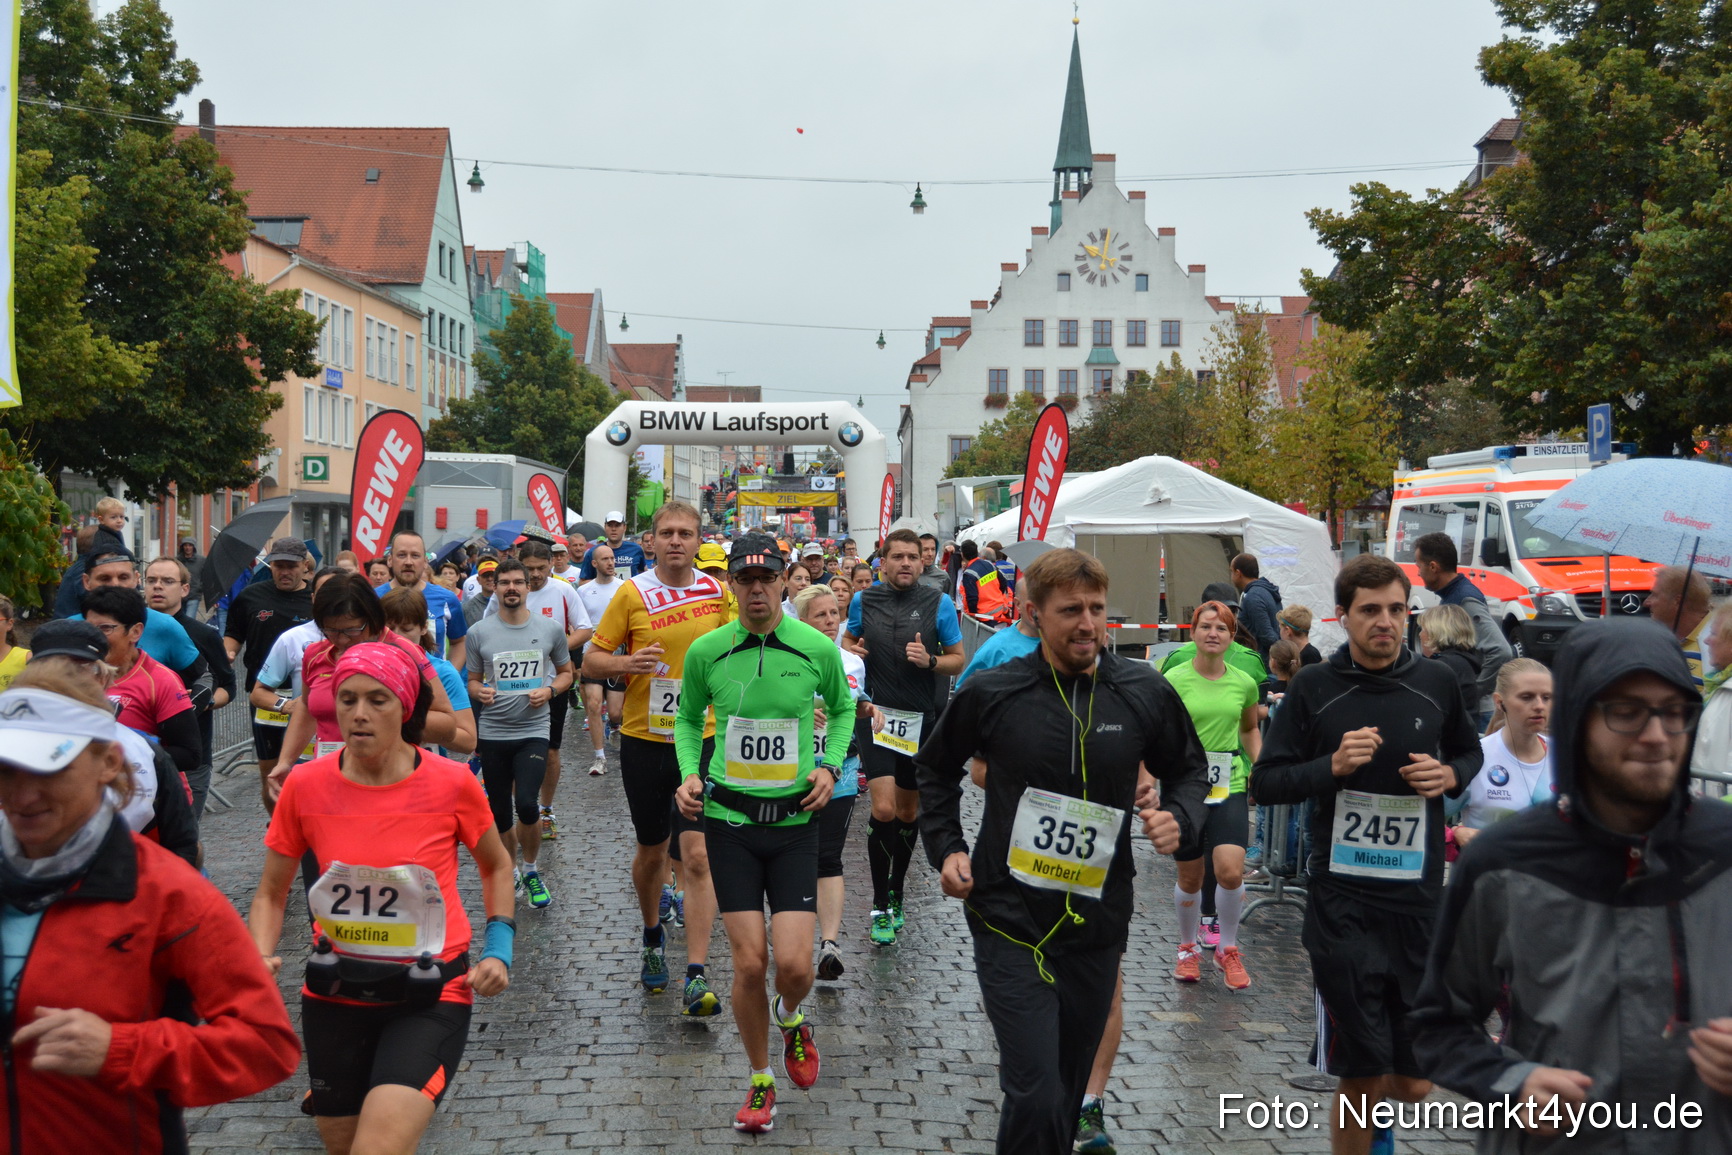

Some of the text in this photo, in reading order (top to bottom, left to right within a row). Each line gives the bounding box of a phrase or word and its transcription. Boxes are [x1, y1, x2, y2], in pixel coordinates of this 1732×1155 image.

[640, 410, 830, 435] BMW Laufsport
[1593, 413, 1605, 454] P
[1534, 445, 1589, 455] EINSATZLEITU
[306, 459, 325, 477] D
[356, 428, 413, 555] REWE
[1023, 425, 1063, 540] REWE
[777, 495, 800, 504] ZIEL
[880, 482, 893, 540] REWE
[650, 611, 689, 631] MAX
[499, 660, 540, 679] 2277
[759, 720, 793, 730] BOCK
[888, 719, 908, 737] 16
[1104, 724, 1122, 732] asics
[740, 735, 785, 761] 608
[881, 735, 910, 750] Wolfgang
[1487, 789, 1511, 797] PARTL
[1378, 798, 1420, 809] BOCK
[1033, 815, 1097, 860] 353
[1342, 812, 1420, 846] 2457
[1354, 851, 1403, 867] Michael
[1032, 859, 1081, 881] Norbert
[330, 883, 399, 917] 212
[335, 925, 389, 942] Kristina
